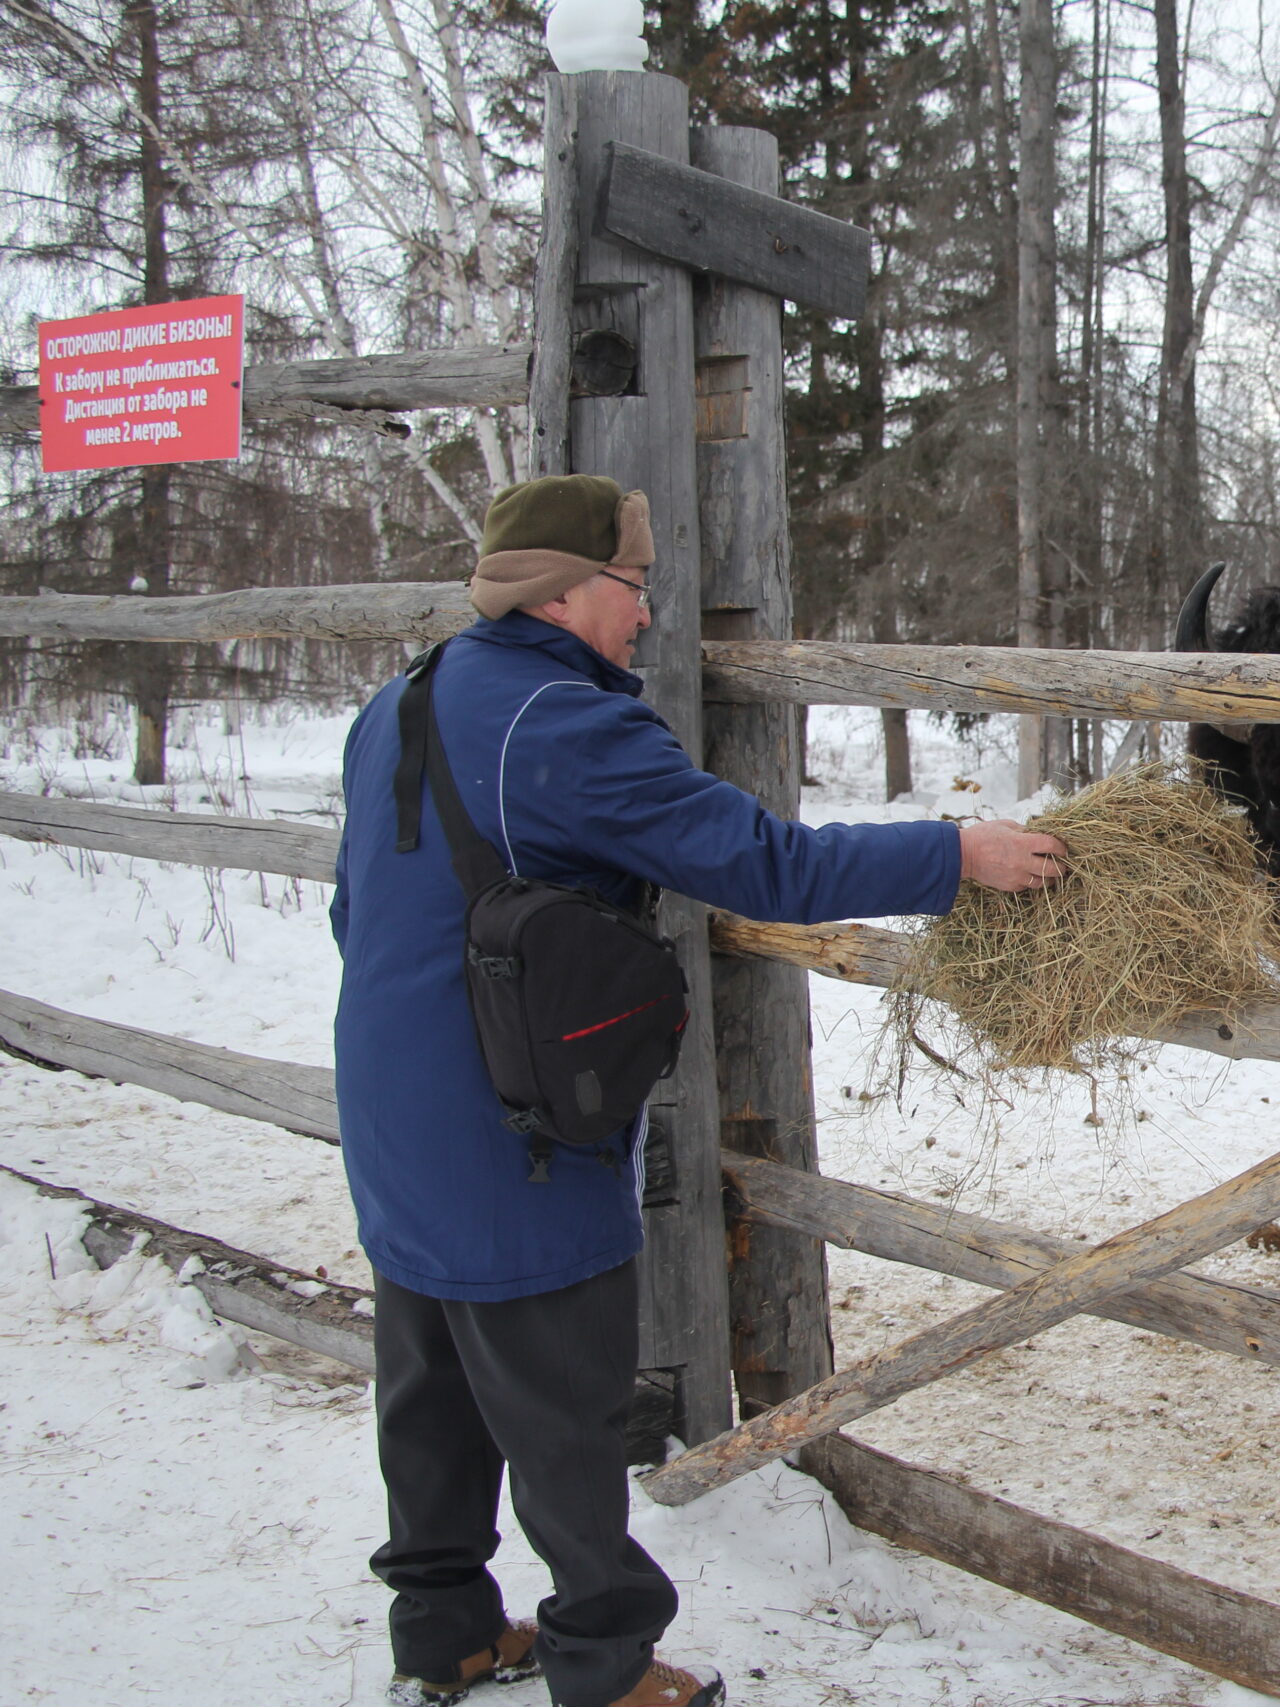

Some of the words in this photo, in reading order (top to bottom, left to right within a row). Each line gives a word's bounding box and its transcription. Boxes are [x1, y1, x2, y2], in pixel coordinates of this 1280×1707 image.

[47, 329, 120, 360] ОСТОРОЖНО!
[123, 323, 166, 353] ДИКИЕ
[169, 314, 232, 344] БИЗОНЫ!
[55, 373, 64, 392] К
[65, 368, 104, 393] забору
[106, 368, 120, 387] не
[123, 357, 219, 389] приближаться.
[65, 398, 125, 423] Дистанция
[128, 399, 140, 413] от
[143, 387, 188, 414] забора
[191, 388, 207, 407] не
[86, 426, 120, 446] менее
[123, 421, 130, 442] 2
[132, 421, 182, 445] метров.
